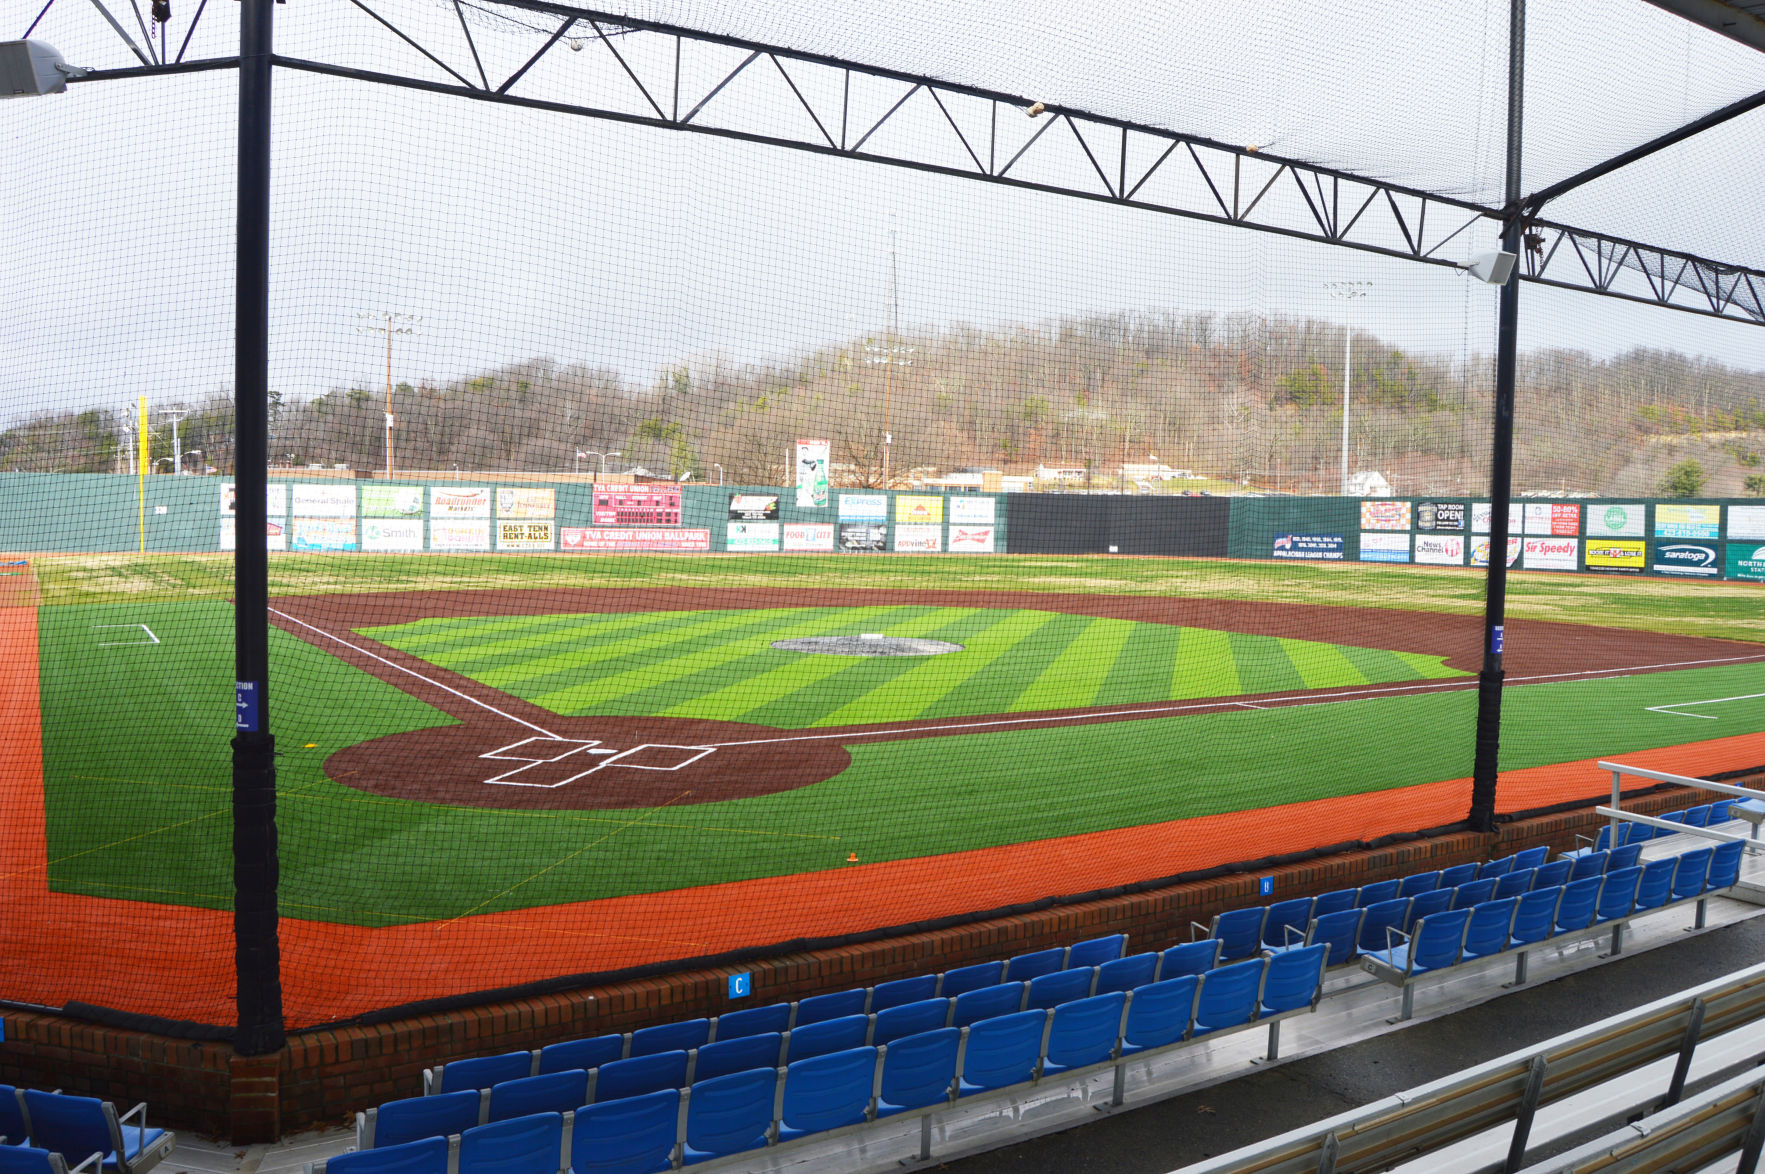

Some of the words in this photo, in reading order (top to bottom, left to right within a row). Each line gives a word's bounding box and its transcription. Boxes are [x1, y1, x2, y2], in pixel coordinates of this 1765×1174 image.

[1437, 511, 1464, 520] OPEN!
[382, 526, 414, 538] Smith
[585, 531, 601, 539] TVA
[604, 532, 633, 540] CREDIT
[636, 532, 660, 540] UNION
[664, 532, 706, 541] BALLPARK
[785, 531, 805, 539] FOOD
[816, 531, 832, 539] CITY
[1525, 542, 1538, 552] Sir
[1539, 541, 1576, 557] Speedy
[1664, 551, 1705, 561] saratoga
[735, 977, 743, 994] C
